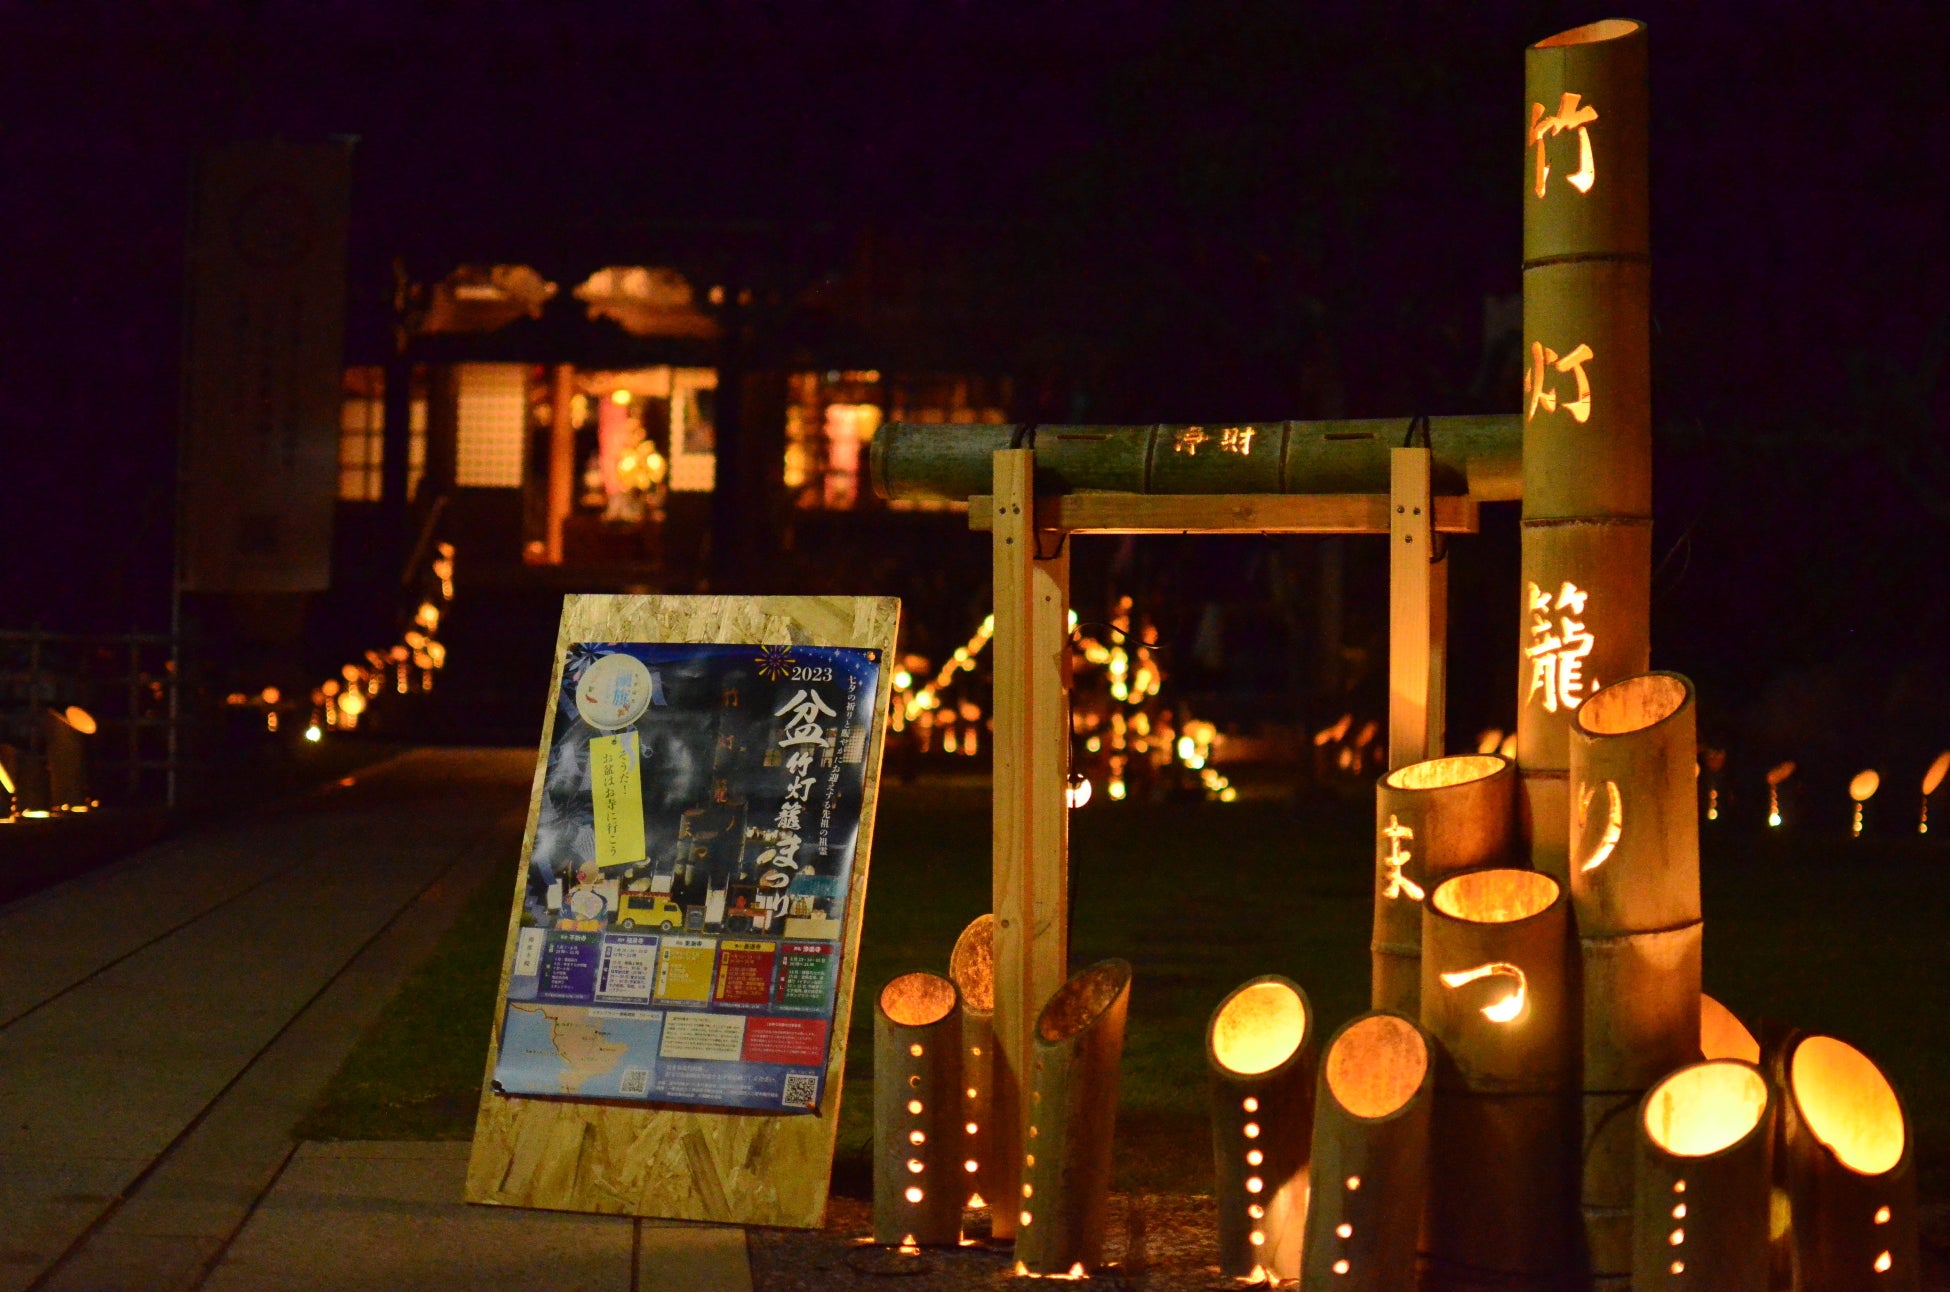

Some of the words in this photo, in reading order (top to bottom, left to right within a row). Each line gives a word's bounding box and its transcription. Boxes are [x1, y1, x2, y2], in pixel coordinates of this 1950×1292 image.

[1175, 425, 1257, 456] 浄財
[1526, 92, 1601, 713] 竹灯籠
[791, 666, 833, 682] 2023
[603, 753, 617, 857] お盆はお寺に行こう
[766, 688, 837, 918] 盆竹灯籠まつり
[1577, 780, 1623, 874] り
[1382, 815, 1425, 901] ま
[1439, 962, 1528, 1024] つ
